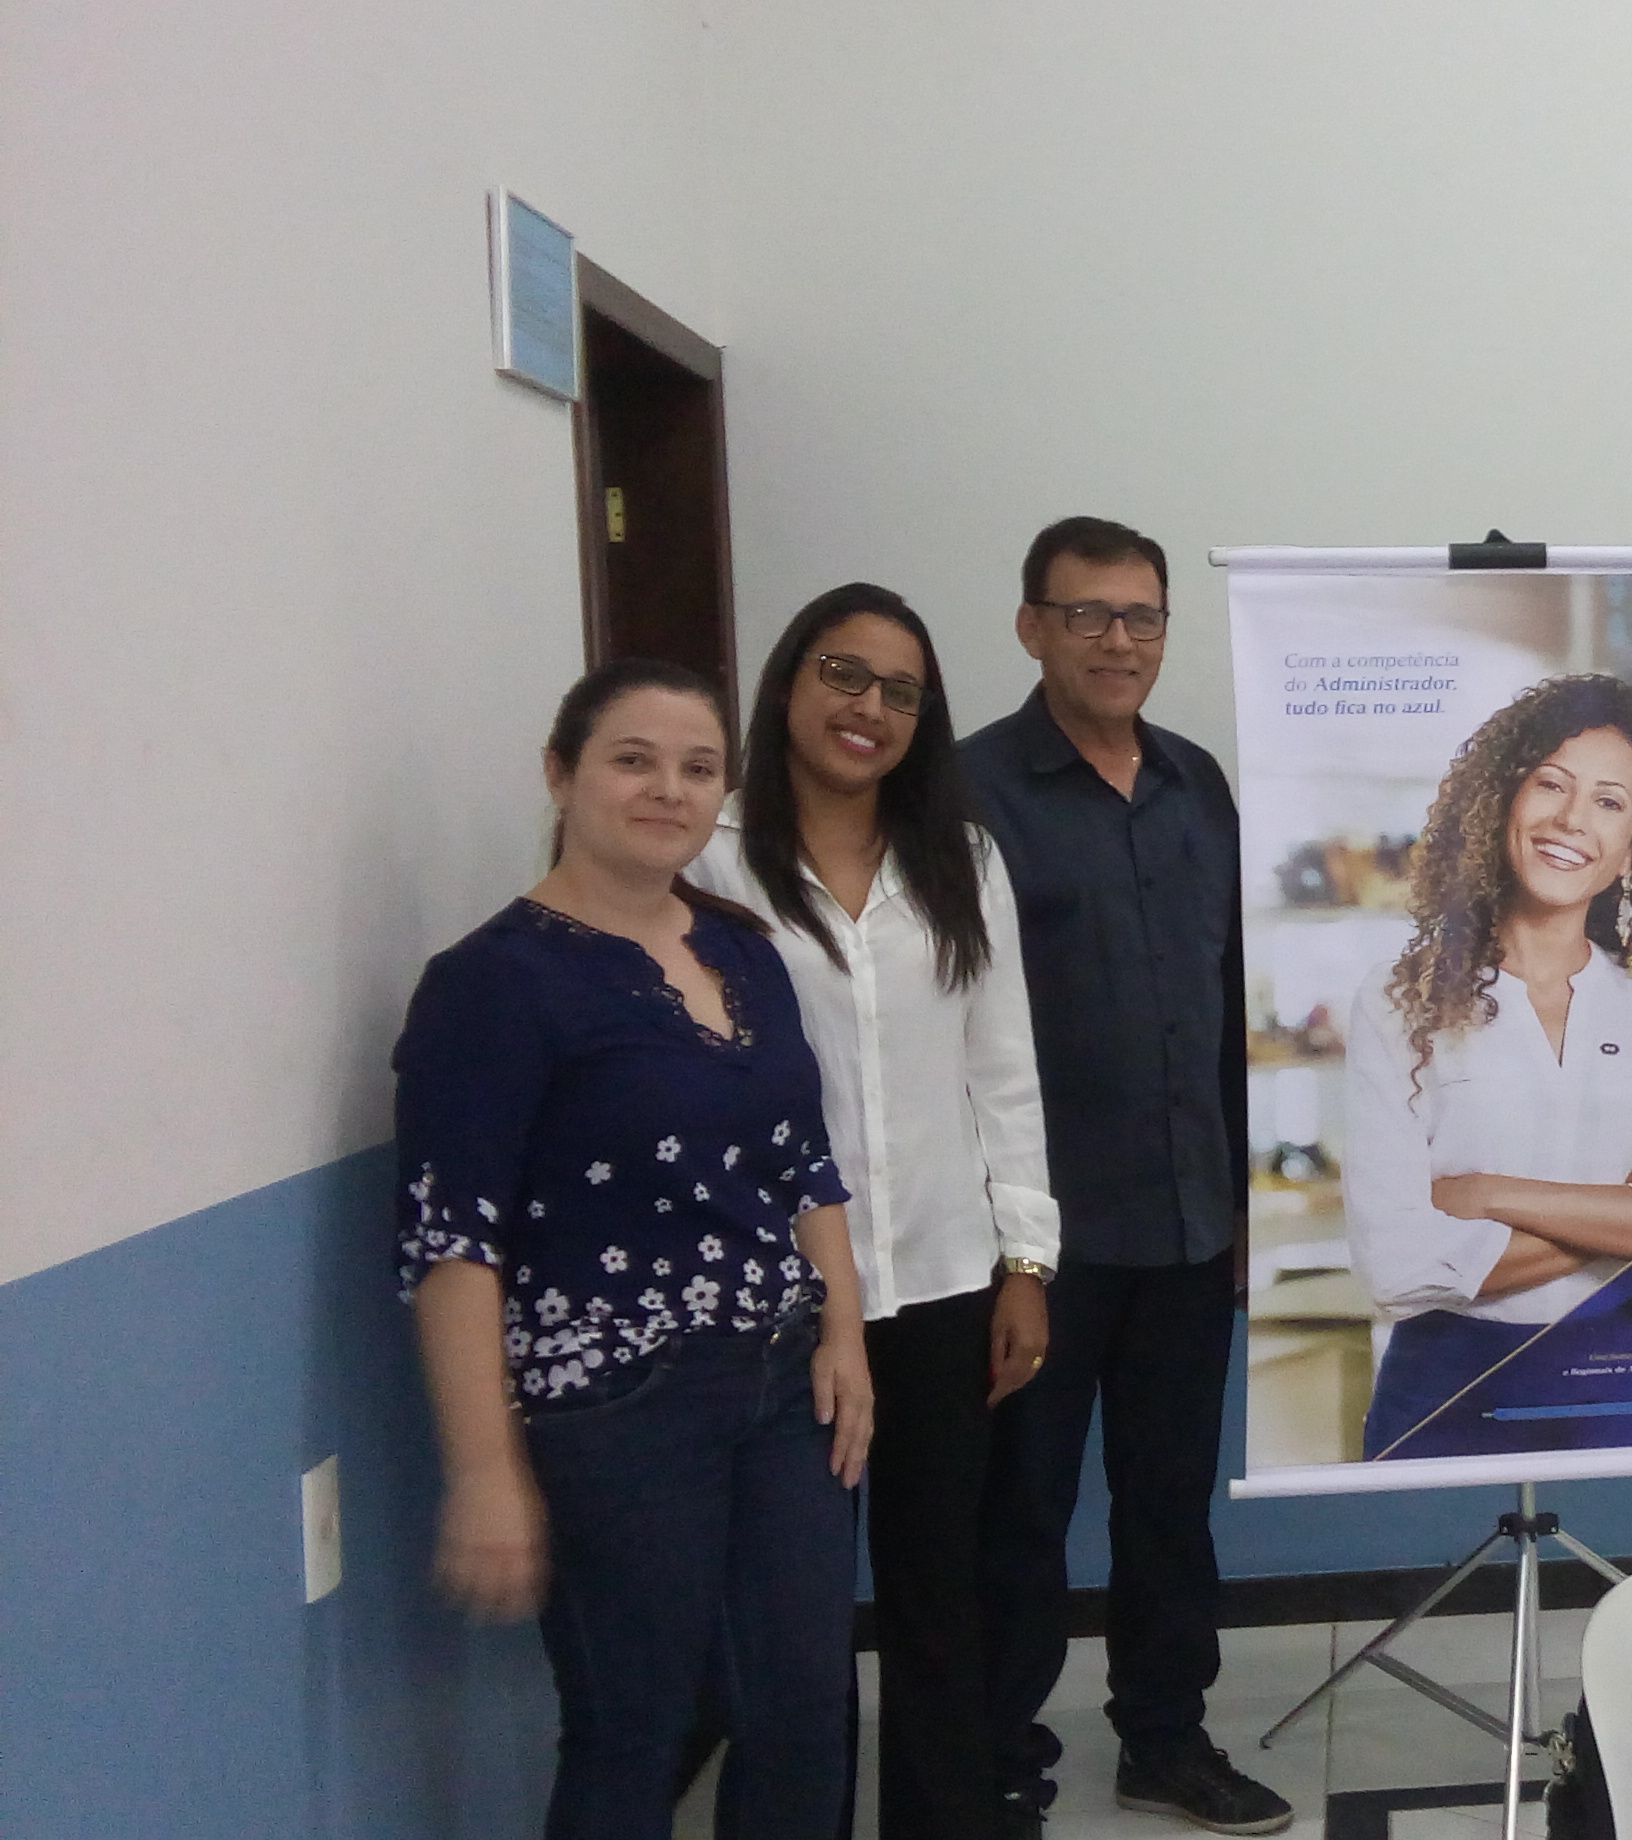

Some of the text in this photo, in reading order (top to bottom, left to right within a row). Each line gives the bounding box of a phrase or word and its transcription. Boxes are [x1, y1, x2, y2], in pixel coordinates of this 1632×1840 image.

[1284, 652, 1459, 671] Com a competência
[1284, 676, 1307, 692] do
[1285, 701, 1329, 715] tudo
[1334, 699, 1366, 715] fica
[1373, 701, 1396, 714] no
